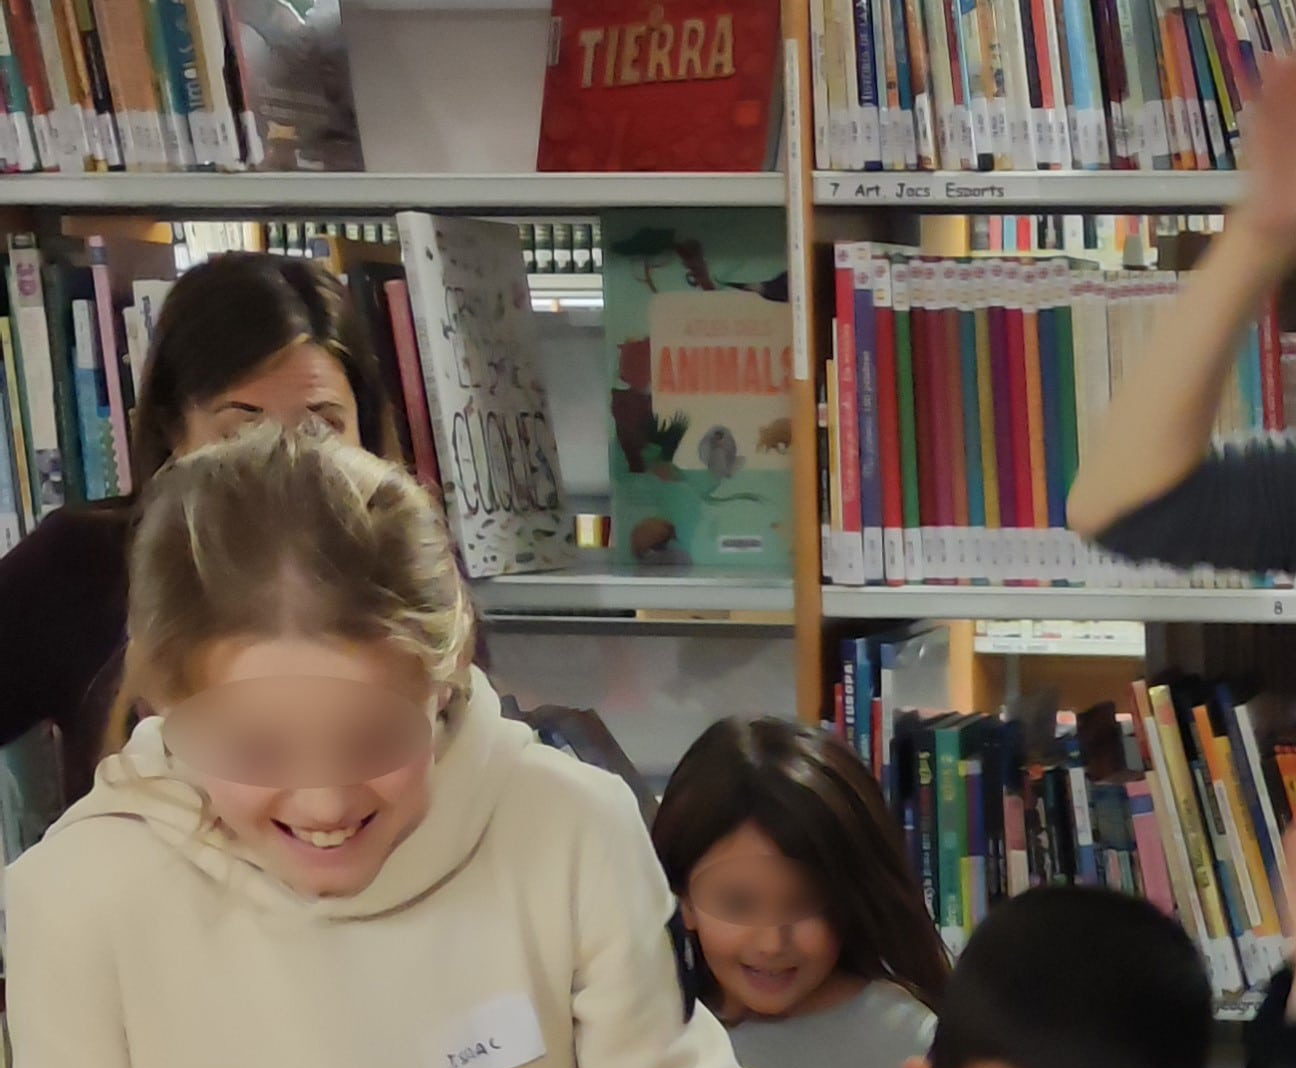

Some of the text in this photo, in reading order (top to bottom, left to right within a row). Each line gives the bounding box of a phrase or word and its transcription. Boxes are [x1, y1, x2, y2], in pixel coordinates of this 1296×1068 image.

[579, 14, 736, 89] TIERRA
[829, 183, 840, 197] 7
[1273, 601, 1283, 615] 8
